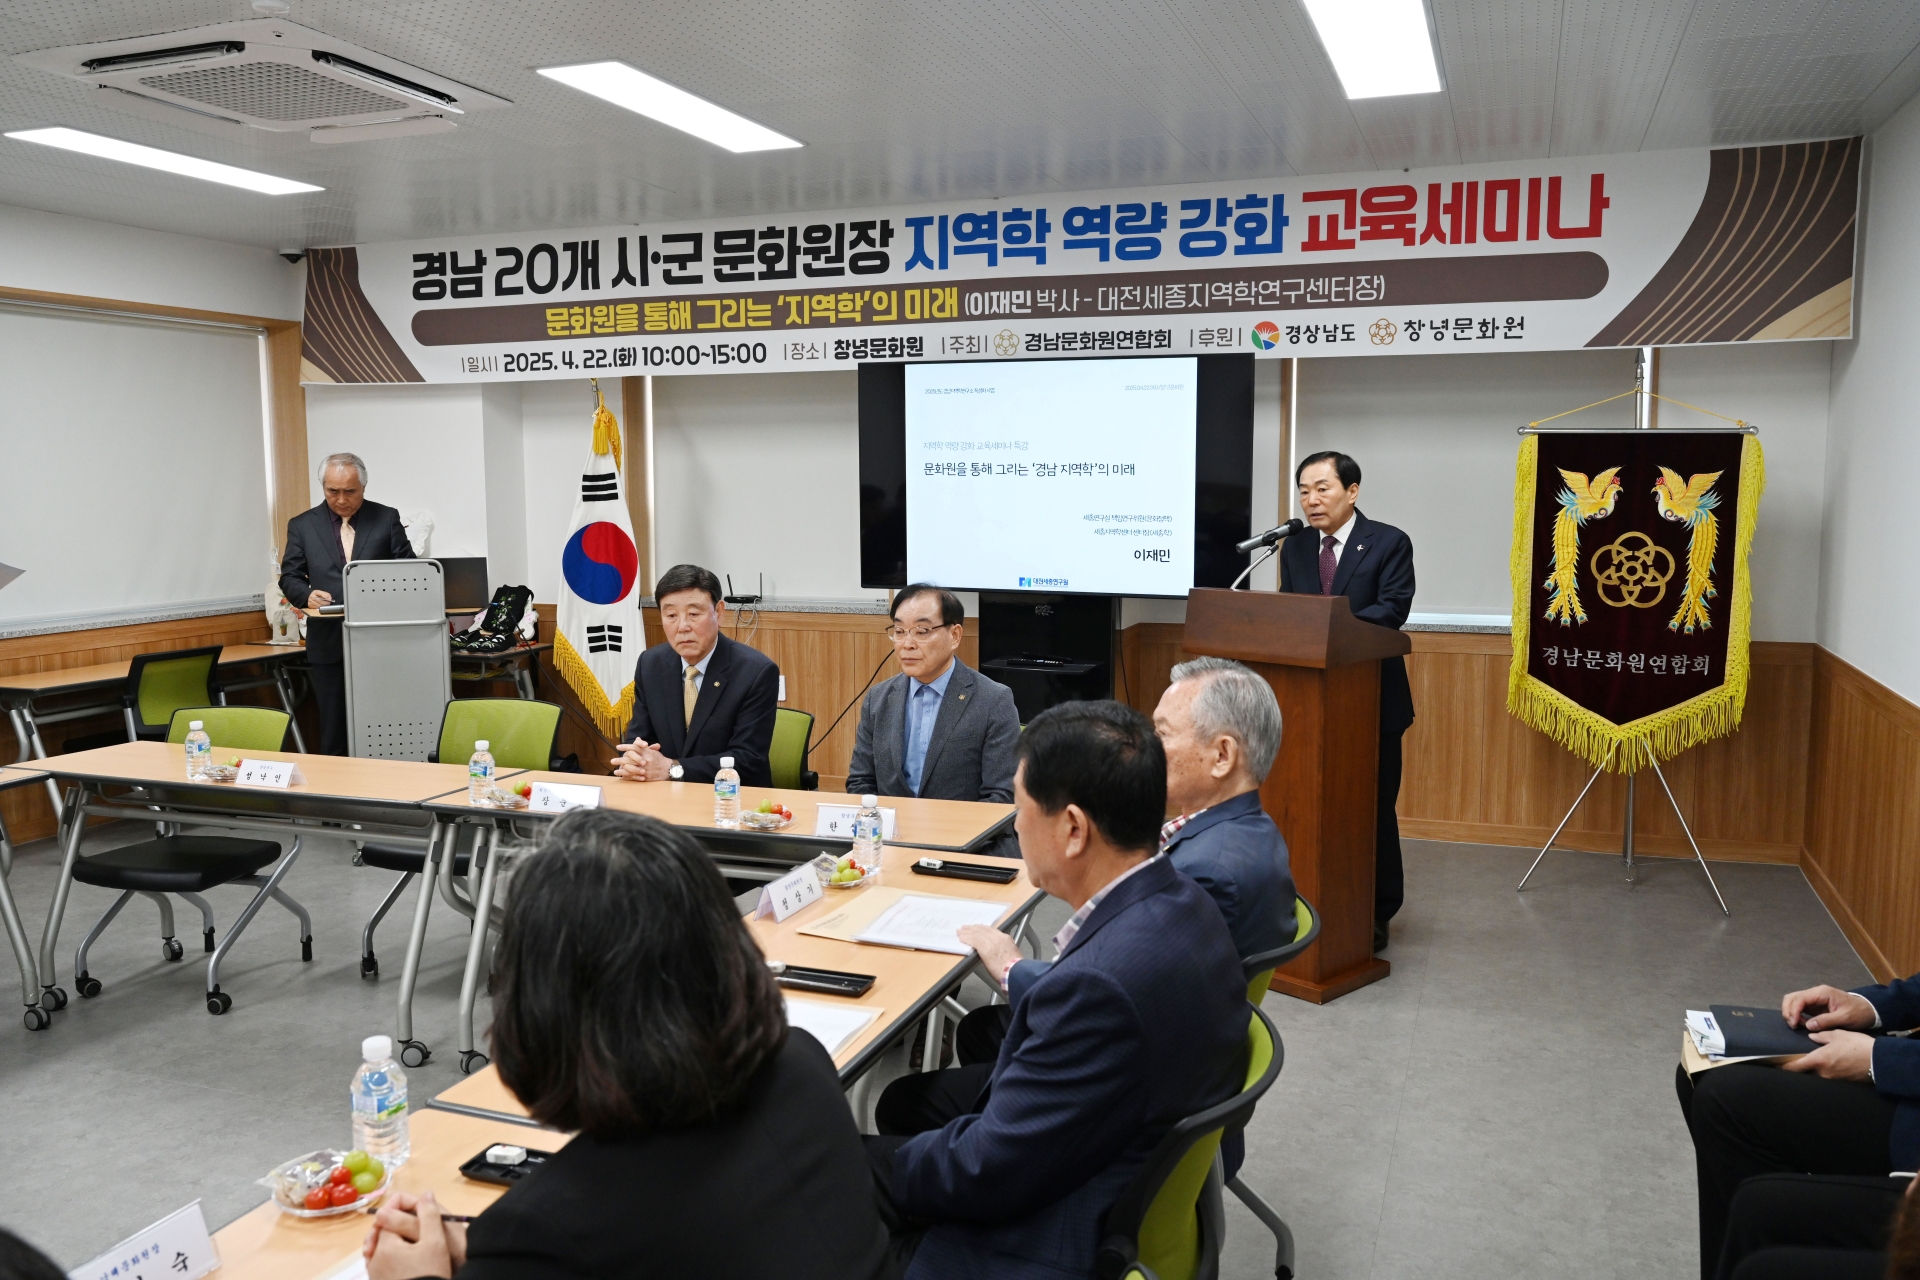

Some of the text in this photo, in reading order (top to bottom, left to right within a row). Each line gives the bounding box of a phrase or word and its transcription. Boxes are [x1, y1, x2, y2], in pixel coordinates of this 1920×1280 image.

[412, 173, 1611, 301] 경남 20개 시·군 문화원장 지역학 역량 강화 교육세미나
[545, 302, 639, 336] 문화원을
[643, 301, 692, 332] 통해
[696, 298, 773, 330] 그리는
[904, 286, 959, 321] 미래
[964, 290, 1033, 317] (이재민
[1036, 287, 1080, 314] 박사
[1097, 274, 1386, 312] 대전세종지역학연구센터장)
[503, 351, 558, 373] 2025.
[561, 351, 579, 370] 4.
[641, 342, 768, 365] 10:00~15:00
[833, 335, 924, 361] 창녕문화원
[1024, 329, 1173, 352] 경남문화원연합회
[1285, 323, 1356, 345] 경상남도
[1403, 315, 1525, 342] 창녕문화원
[923, 440, 944, 451] 지역학
[960, 441, 976, 451] 강화
[976, 441, 1013, 451] 교육세미나
[1013, 440, 1029, 451] 특강
[923, 462, 968, 477] 문화원을
[970, 462, 993, 477] 통해
[995, 462, 1030, 477] 그리는
[1112, 462, 1135, 477] 미래
[1133, 548, 1171, 563] 이재민
[1542, 645, 1711, 677] 경남문화원연합회
